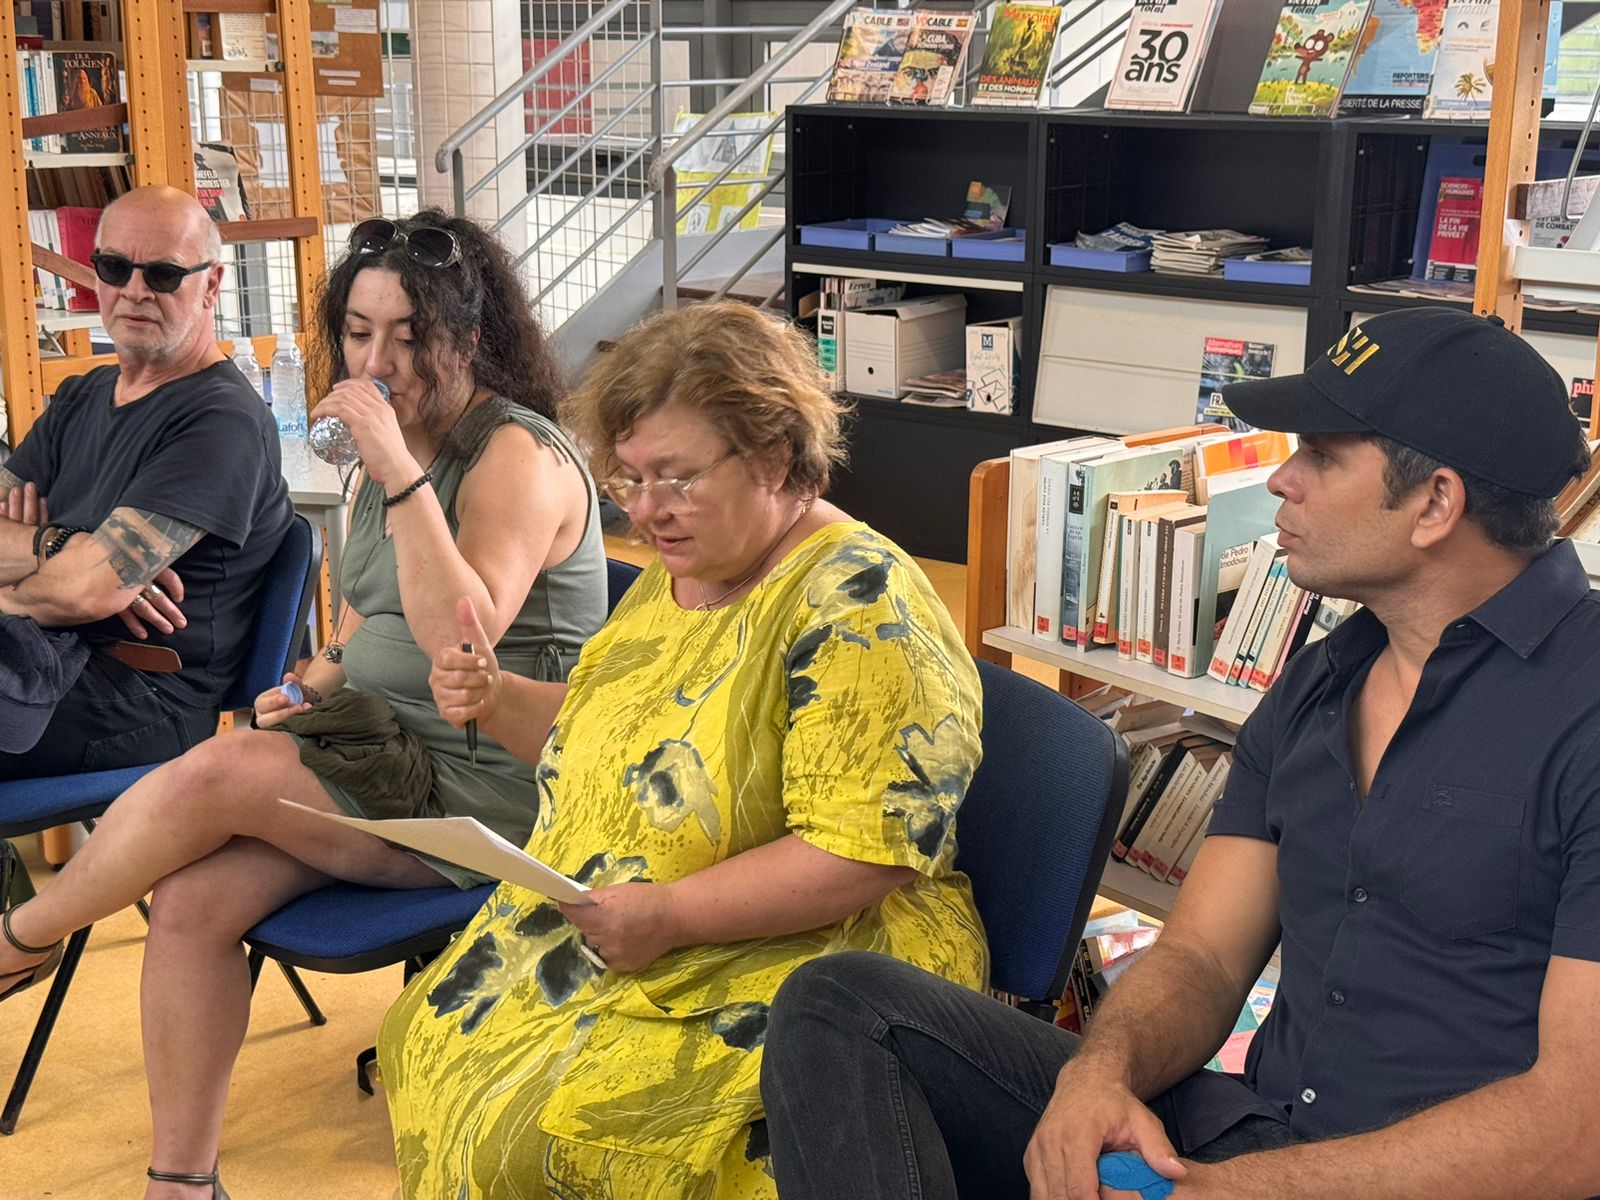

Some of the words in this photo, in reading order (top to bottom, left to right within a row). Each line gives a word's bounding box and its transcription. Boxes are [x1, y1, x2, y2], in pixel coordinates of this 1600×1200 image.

[915, 14, 954, 27] VOCABLE
[1131, 29, 1189, 64] 30
[63, 59, 105, 68] TOLKIEN
[1125, 60, 1182, 83] ans
[1367, 99, 1377, 108] DE
[1379, 99, 1389, 108] LA
[1391, 99, 1422, 109] PRESSE
[1546, 223, 1574, 231] COMBAT
[1231, 547, 1249, 556] Pedro
